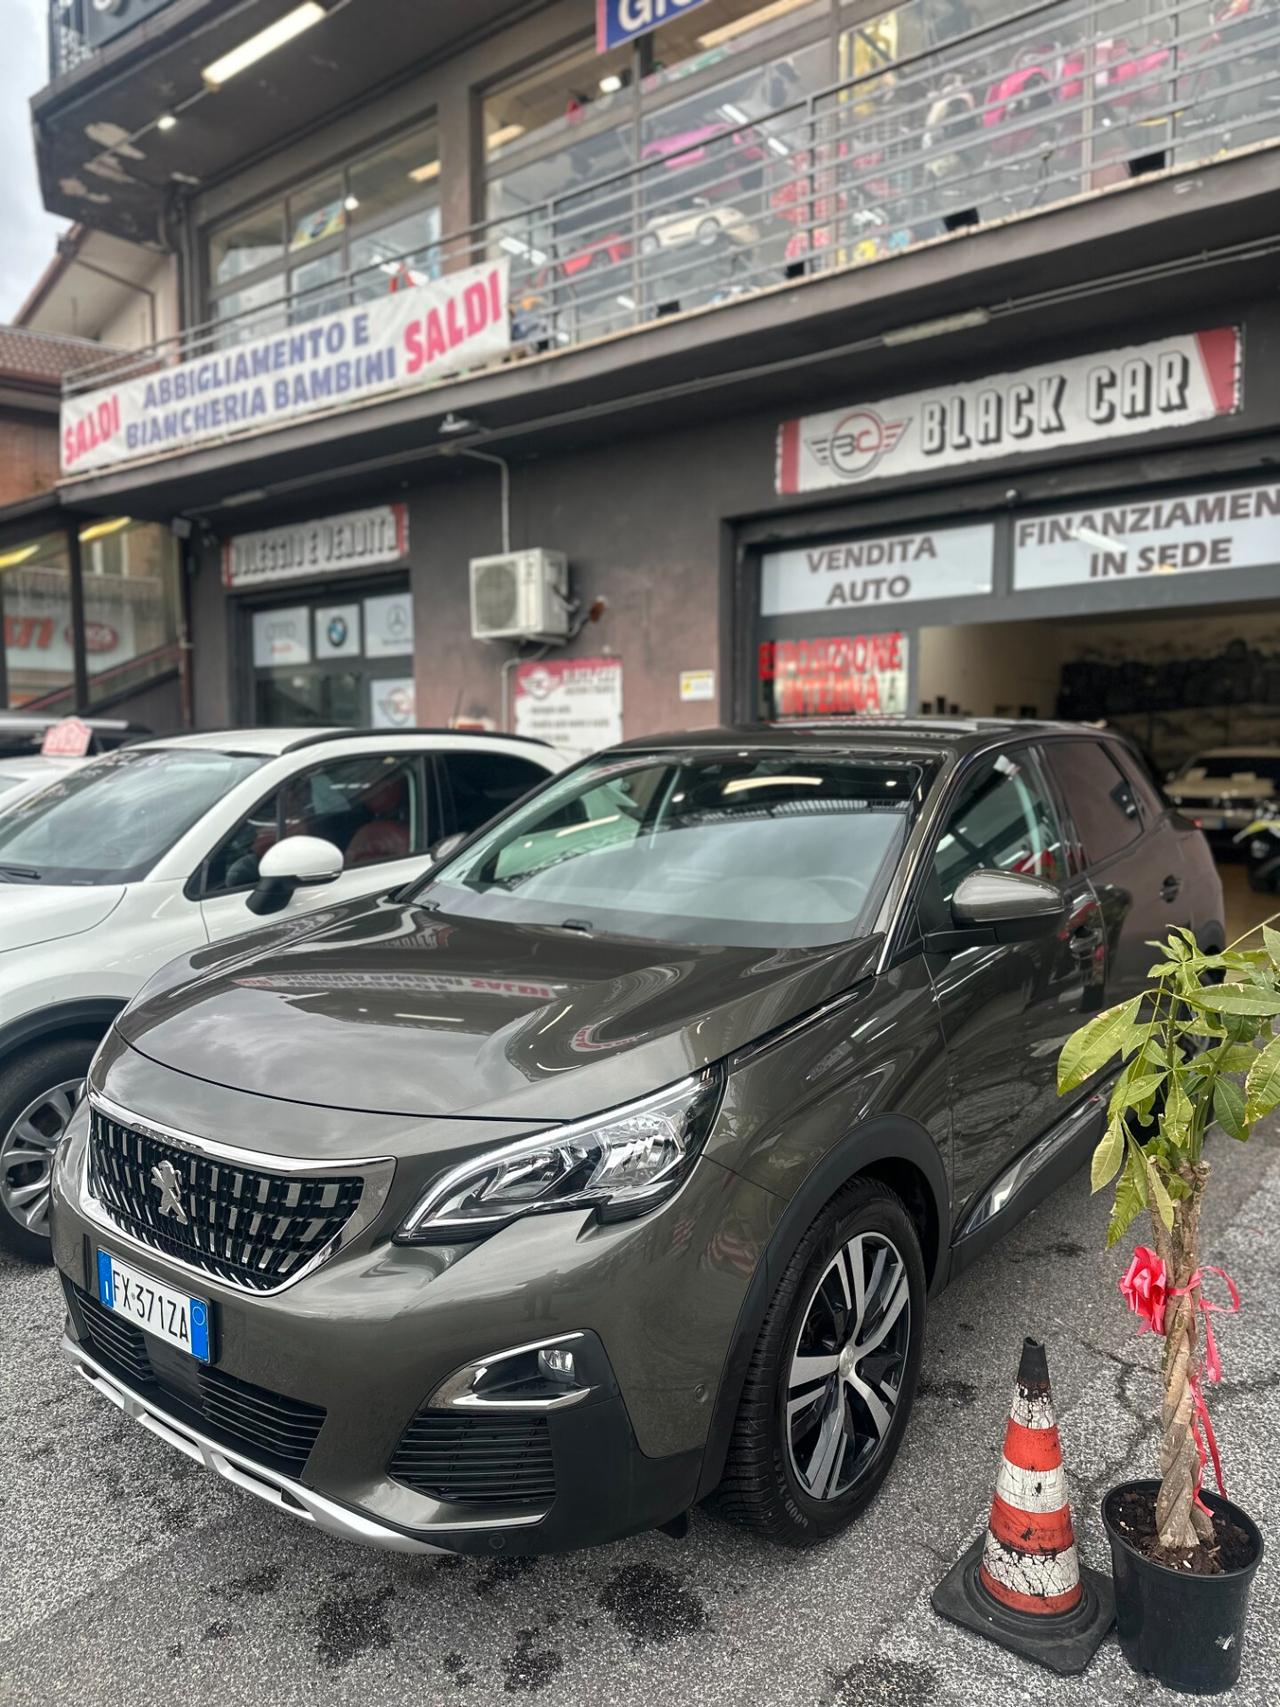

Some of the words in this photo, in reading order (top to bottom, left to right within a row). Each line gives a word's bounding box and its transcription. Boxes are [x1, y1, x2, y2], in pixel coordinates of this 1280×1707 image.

[142, 321, 345, 410] ABBIGLIAMENTO
[352, 312, 370, 347] E
[403, 269, 502, 375] SALDI
[63, 393, 121, 466] SALDI
[125, 386, 268, 449] BIANCHERIA
[273, 346, 396, 410] BAMBINI
[920, 373, 1067, 456] BLACK
[1086, 350, 1190, 425] CAR
[806, 536, 938, 574] VENDITA
[825, 575, 912, 606] AUTO
[1089, 551, 1129, 578] IN
[1137, 536, 1234, 573] SEDE
